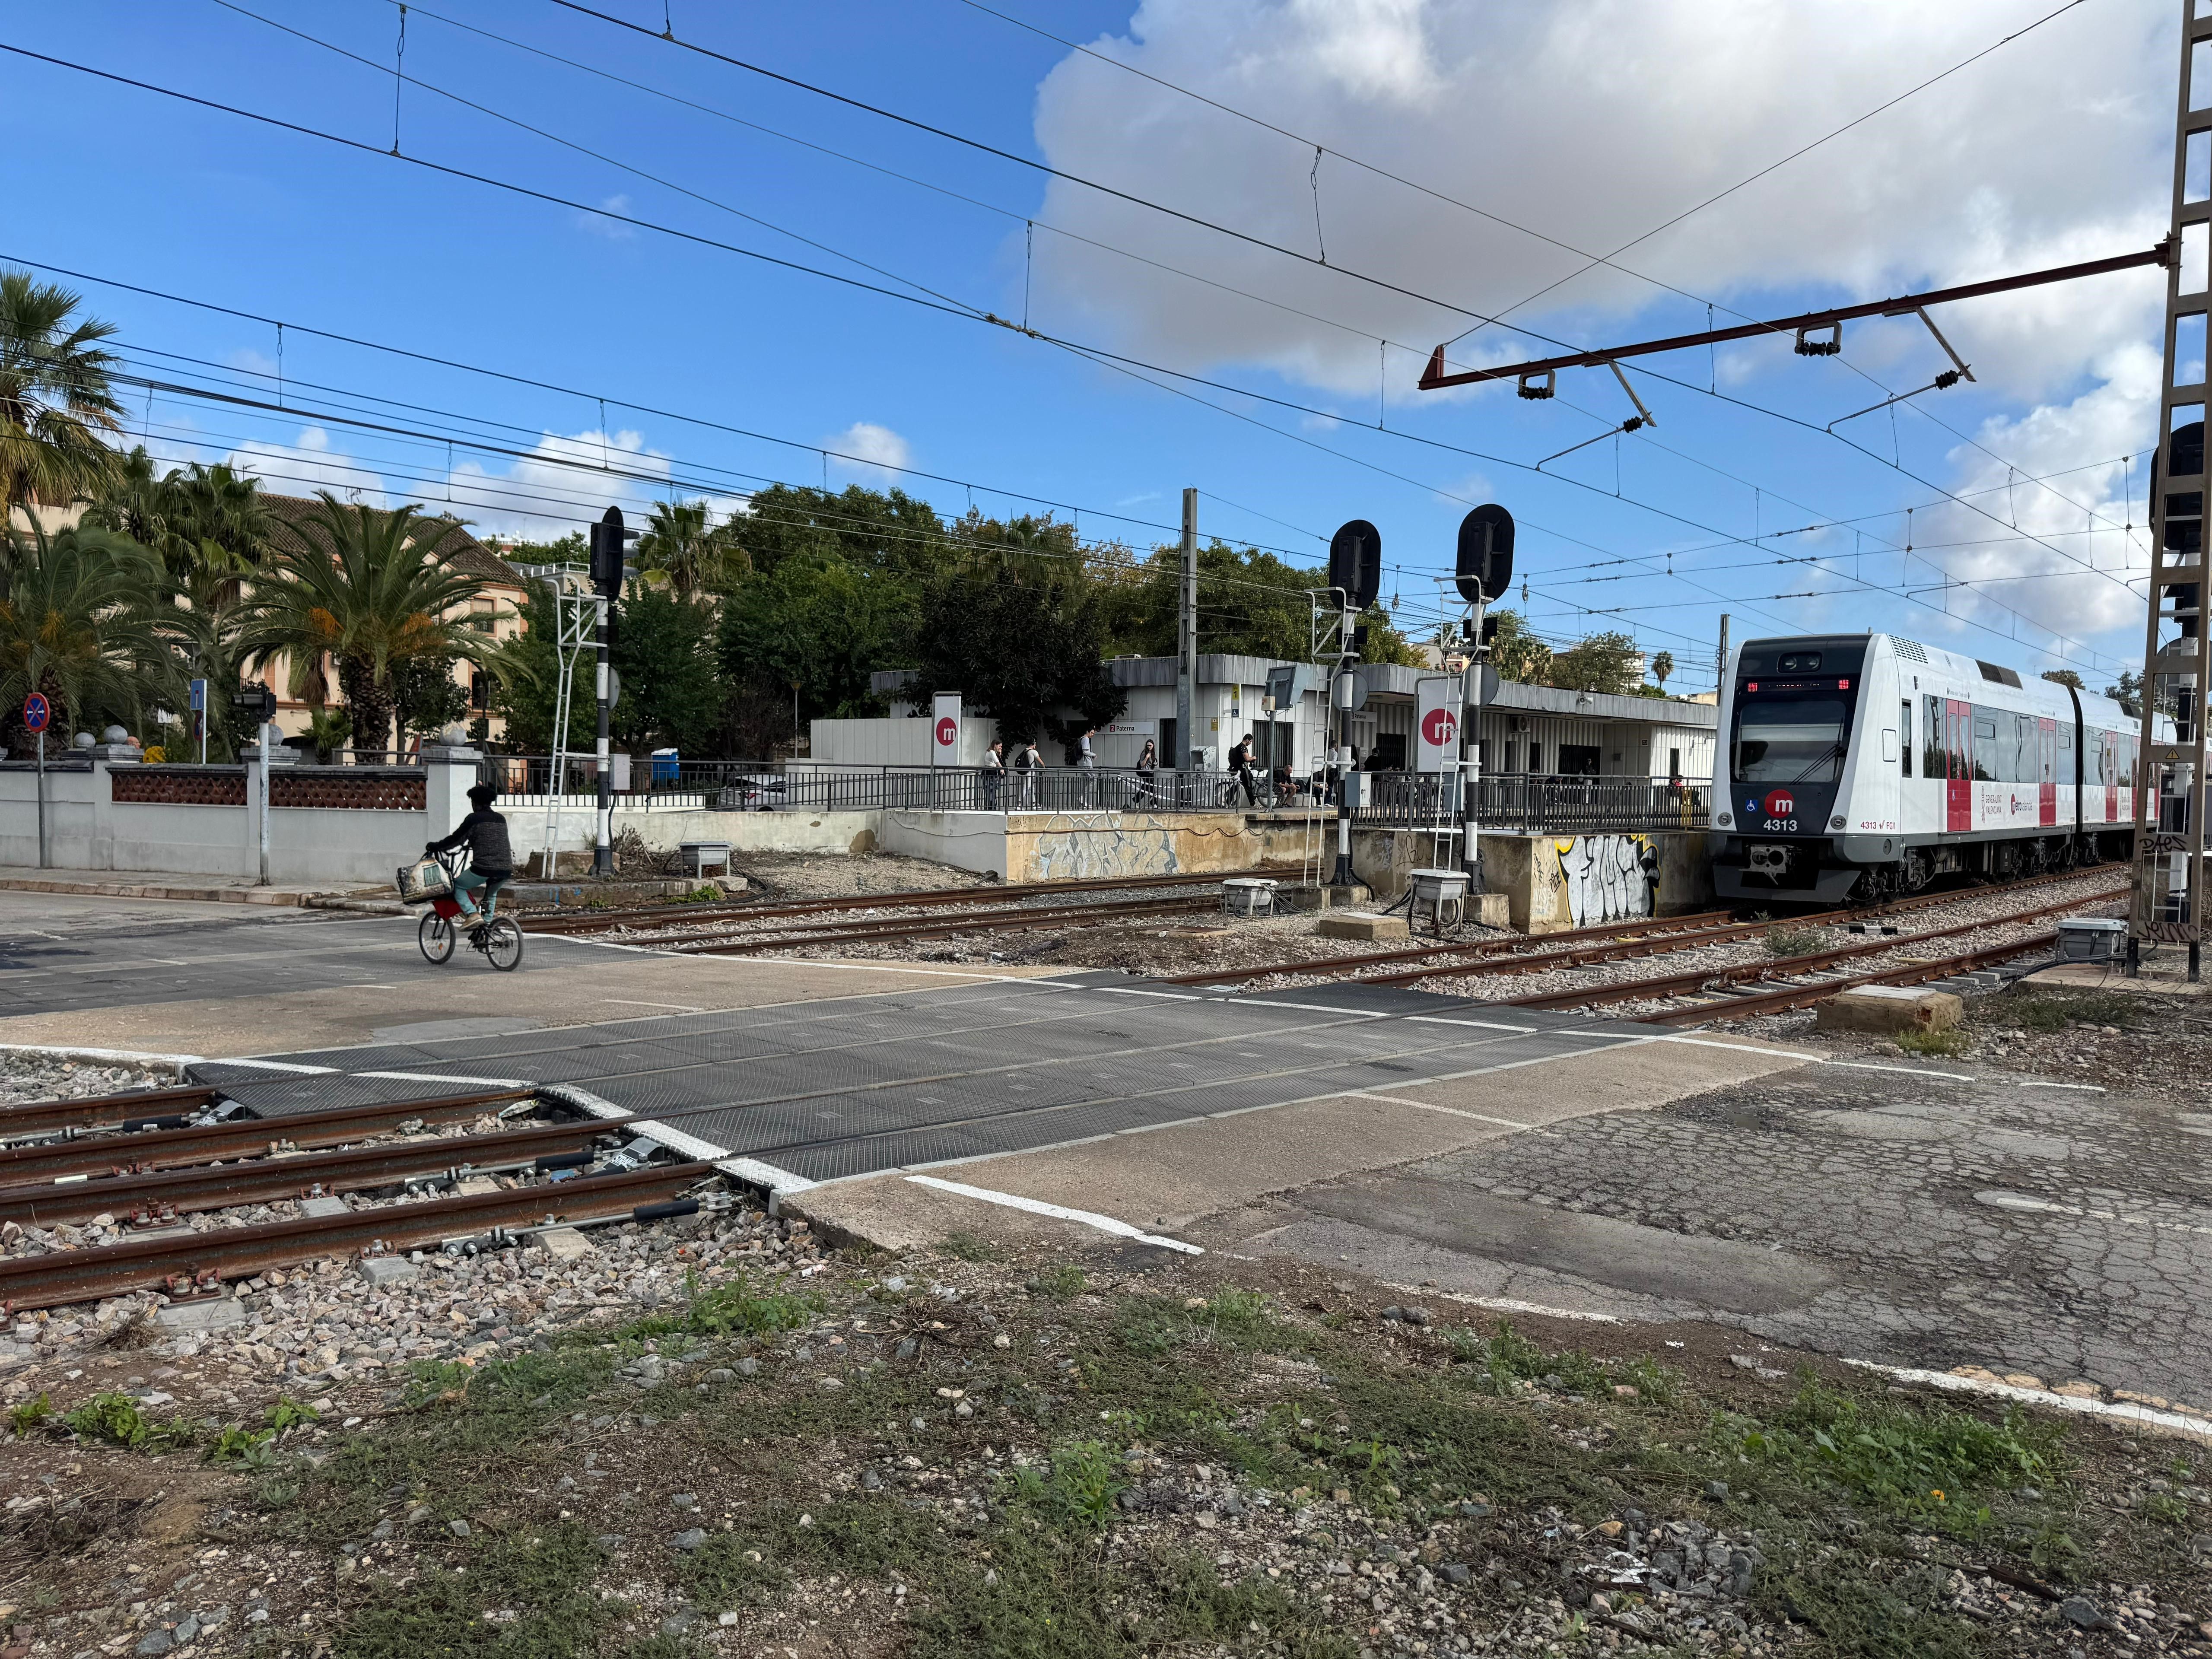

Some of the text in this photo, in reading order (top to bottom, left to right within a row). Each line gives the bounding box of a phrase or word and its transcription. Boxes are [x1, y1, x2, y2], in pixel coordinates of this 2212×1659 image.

[943, 728, 956, 741] m
[1435, 723, 1454, 738] m
[1775, 800, 1792, 812] m
[1763, 820, 1797, 831] 4313
